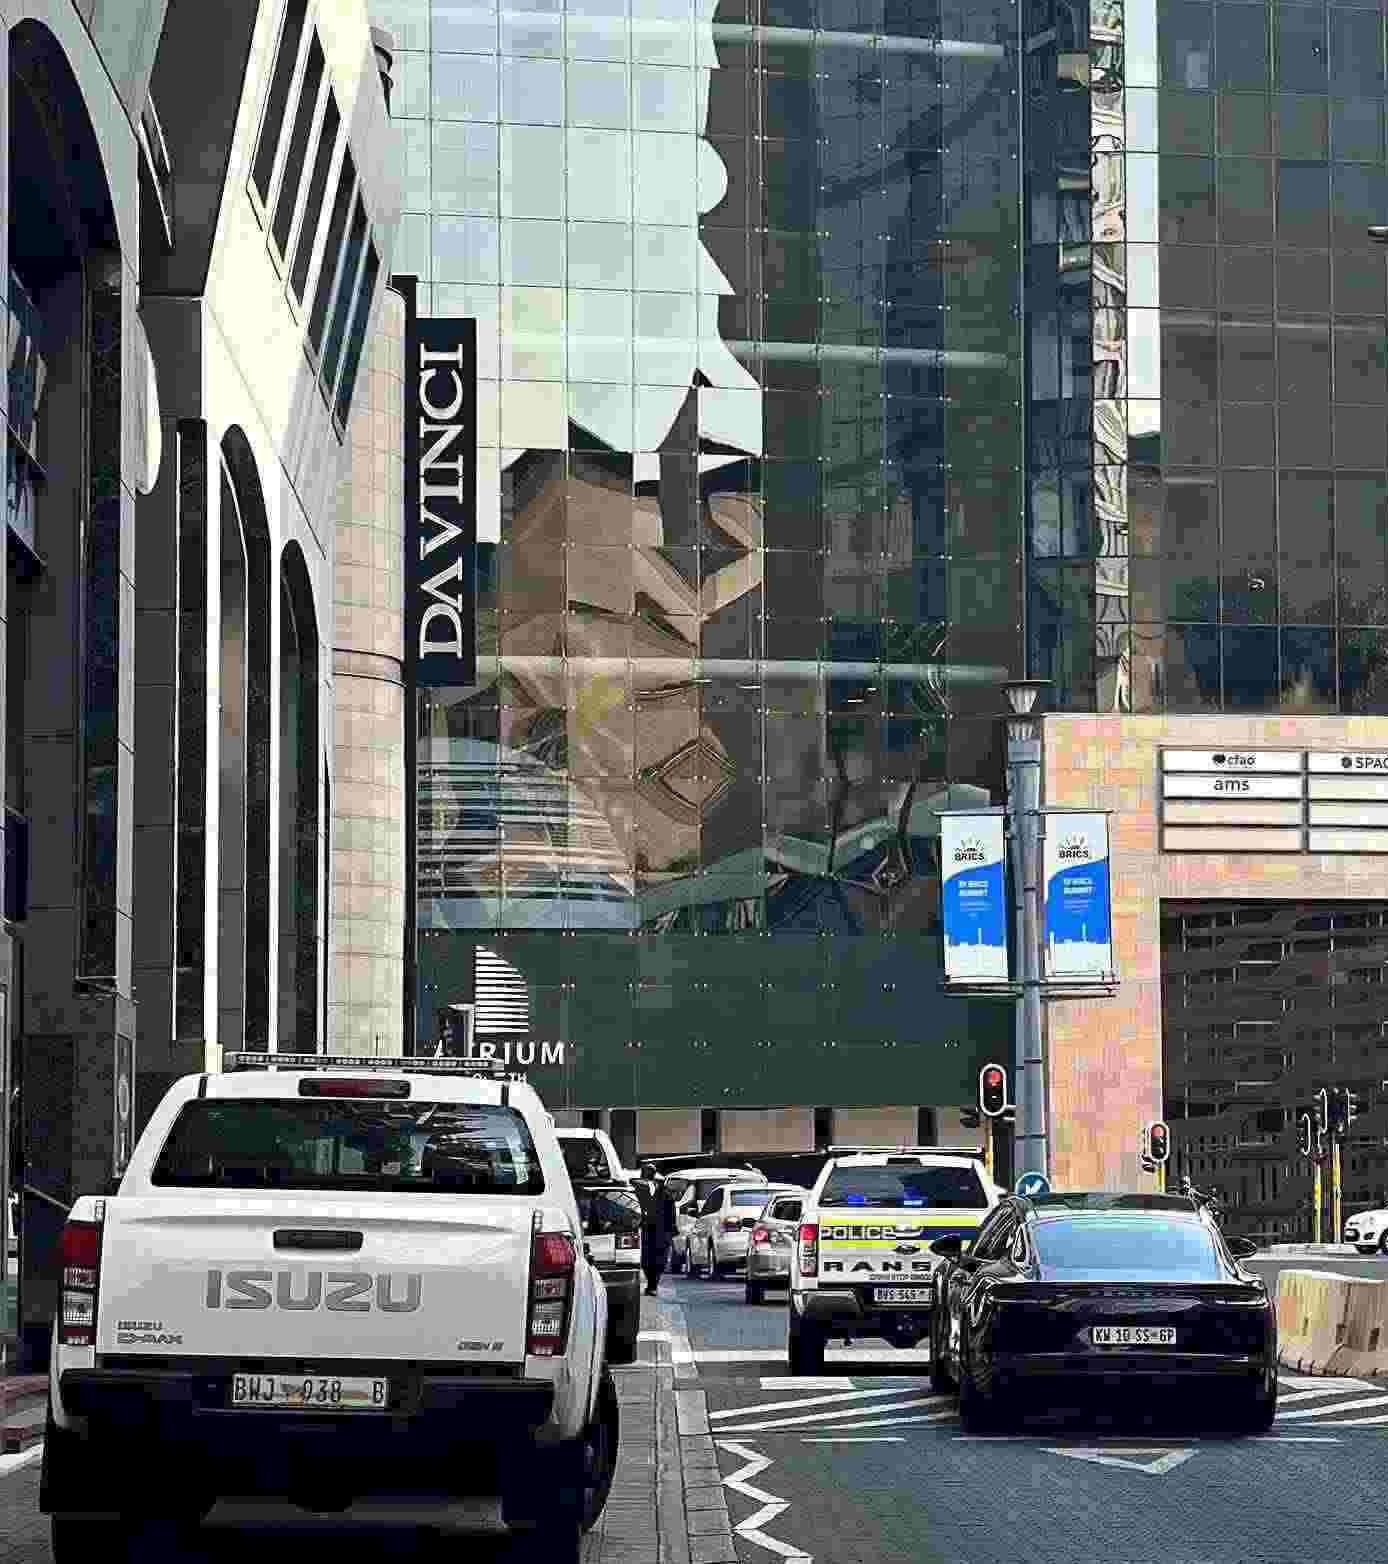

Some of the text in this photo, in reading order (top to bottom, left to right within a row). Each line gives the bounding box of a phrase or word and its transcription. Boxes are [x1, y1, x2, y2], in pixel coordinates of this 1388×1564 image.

[1213, 780, 1250, 792] ams
[479, 1041, 565, 1065] RIUM
[820, 1225, 897, 1240] POLICE
[823, 1261, 932, 1272] RANG
[205, 1269, 422, 1313] ISUZU
[372, 1381, 383, 1403] B
